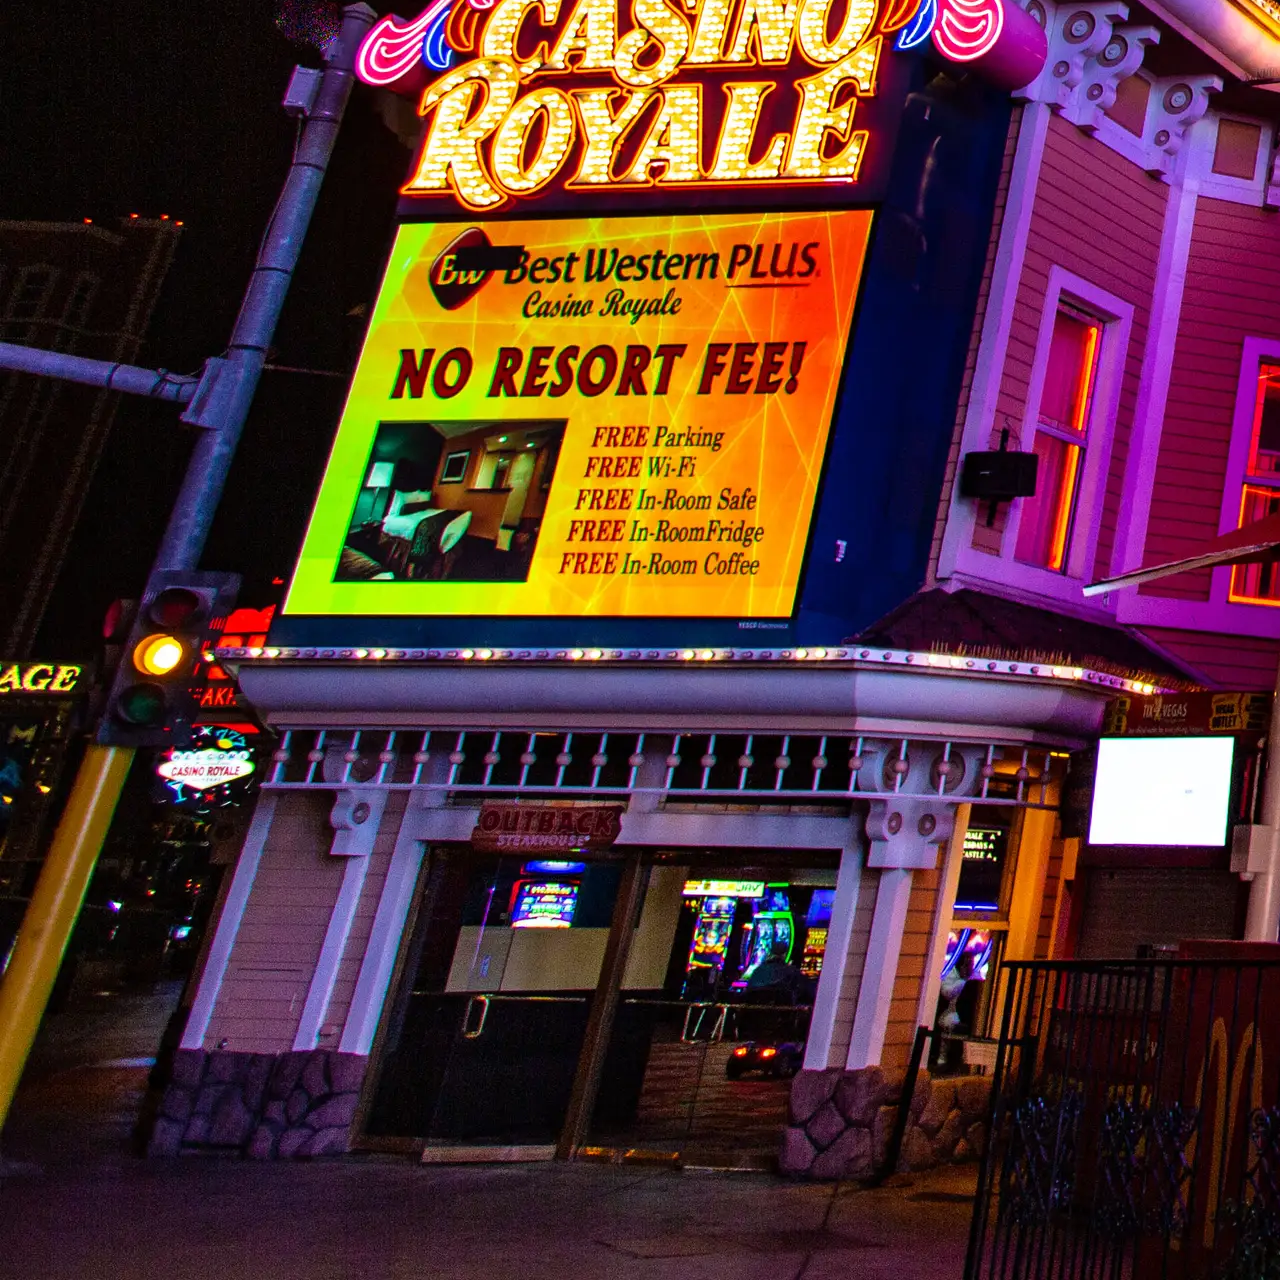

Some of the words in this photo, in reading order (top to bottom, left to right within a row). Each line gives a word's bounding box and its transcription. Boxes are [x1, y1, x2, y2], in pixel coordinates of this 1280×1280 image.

[401, 36, 883, 211] ROYALE
[583, 245, 719, 284] Western
[727, 242, 820, 279] PLUS
[522, 290, 593, 319] Casino
[598, 286, 683, 324] Royale
[390, 345, 473, 399] NO
[486, 343, 688, 398] RESORT
[697, 341, 807, 396] FEE!
[591, 426, 650, 448] FREE
[652, 425, 725, 453] Parking
[584, 457, 643, 479] FREE
[647, 456, 697, 479] Wi-Fi
[575, 488, 633, 511] FREE
[636, 489, 712, 511] In-Room
[716, 488, 757, 512] Safe
[566, 520, 627, 543] FREE
[558, 552, 619, 576] FREE
[621, 552, 698, 575] In-Room
[703, 551, 760, 576] Coffee
[0, 663, 81, 692] AGE
[171, 766, 205, 777] CASINO
[207, 765, 241, 776] ROYALE
[481, 809, 614, 835] OUTBACK
[496, 835, 586, 847] STEAKHOUSE
